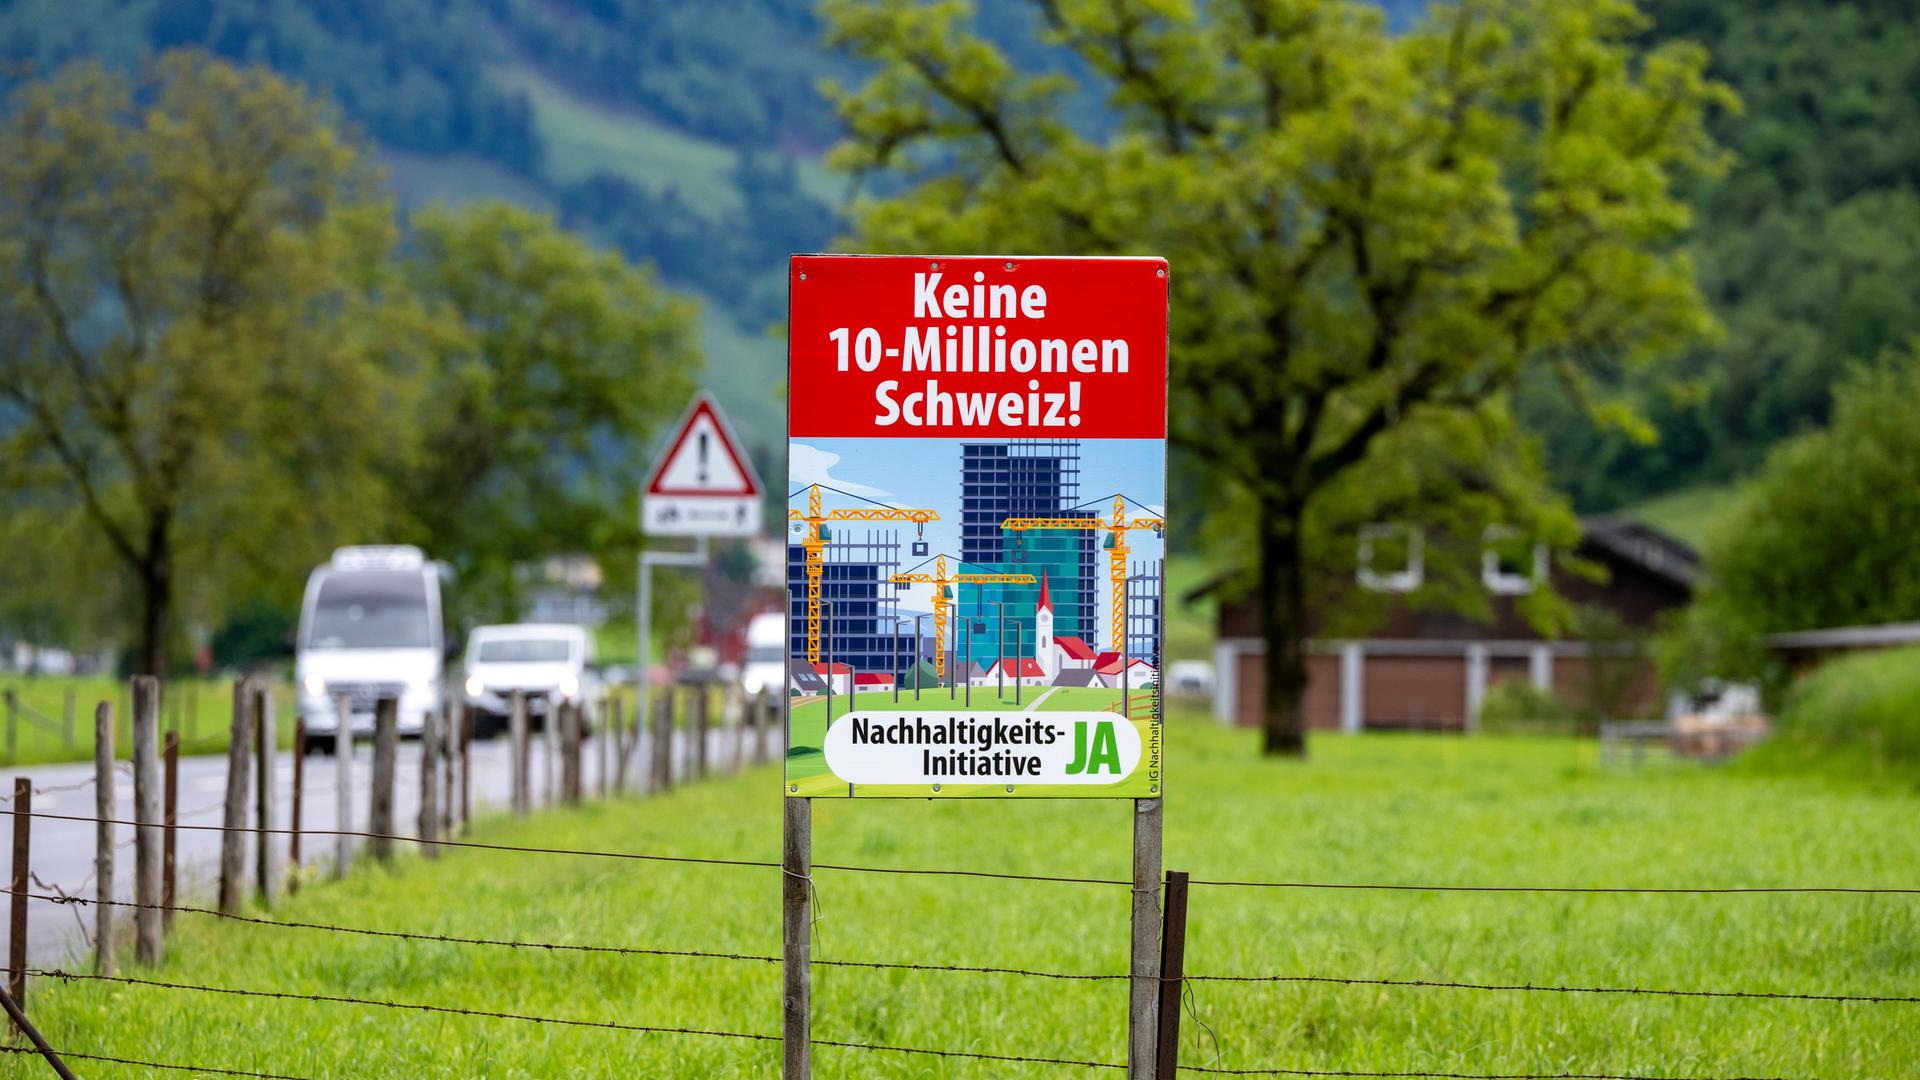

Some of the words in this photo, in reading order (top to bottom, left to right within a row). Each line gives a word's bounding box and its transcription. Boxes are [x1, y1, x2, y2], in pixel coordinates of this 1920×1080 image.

[914, 271, 1047, 318] Keine
[829, 325, 1129, 372] 10-Millionen
[875, 379, 1082, 427] Schweiz!
[852, 717, 1066, 752] Nachhaltigkeits-
[1065, 721, 1122, 775] JA
[923, 749, 1042, 776] Initiative
[1149, 770, 1159, 781] IG
